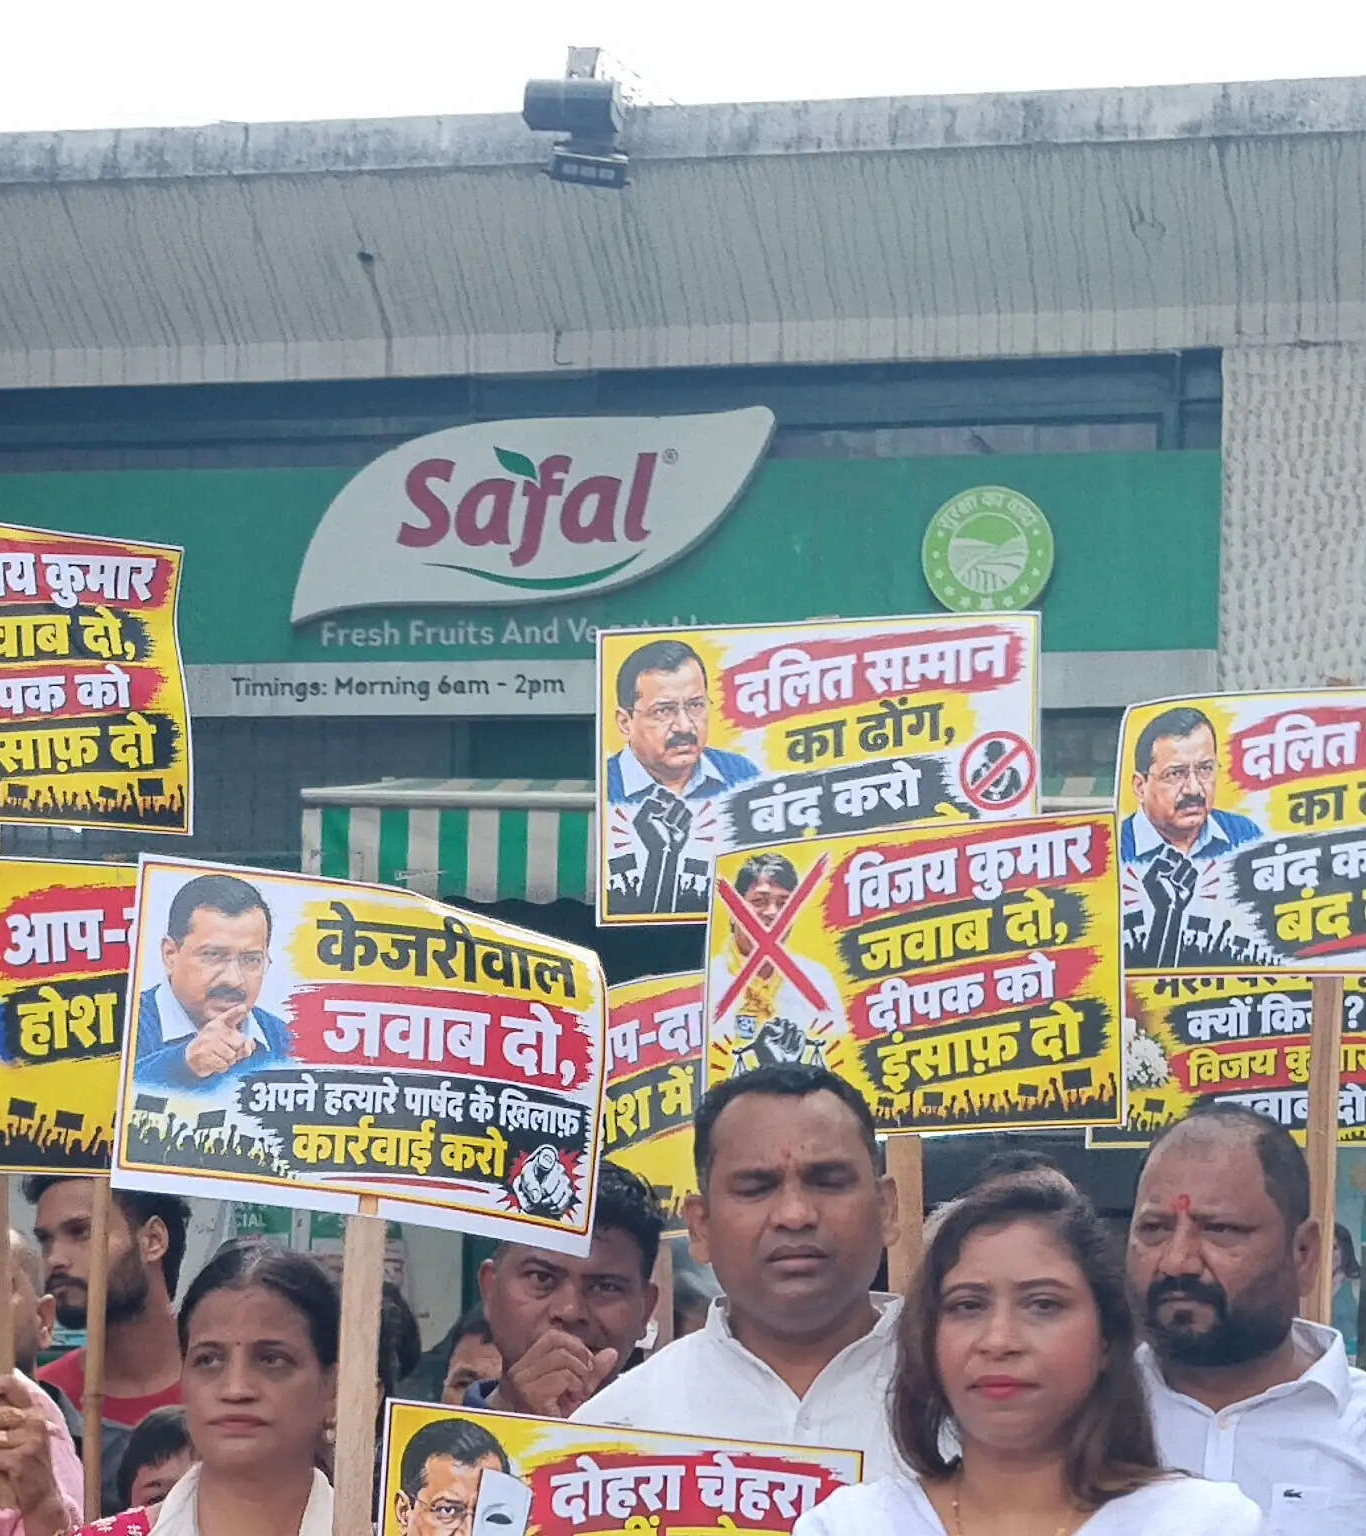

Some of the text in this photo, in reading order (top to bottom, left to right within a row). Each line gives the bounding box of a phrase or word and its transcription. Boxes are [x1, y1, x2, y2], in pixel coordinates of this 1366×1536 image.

[396, 452, 659, 568] Safal
[42, 552, 157, 609] कुमार
[81, 606, 137, 662] दो,
[321, 621, 401, 647] Fresh
[409, 619, 495, 647] Fruits
[502, 618, 560, 645] And
[73, 664, 130, 709] को
[232, 675, 328, 702] Timings:
[335, 674, 431, 702] Morning
[438, 675, 491, 696] 6am
[514, 674, 566, 701] 2pm
[734, 634, 1011, 719] दलित सम्मान
[111, 711, 159, 769] दो
[786, 720, 844, 764] का
[1242, 714, 1359, 779] दलित
[749, 784, 823, 834] बंद
[831, 764, 922, 818] करो
[1288, 783, 1346, 827] का
[845, 825, 1093, 917] विजय कुमार
[1252, 842, 1322, 892] बंद
[858, 889, 1069, 973] जवाब दो,
[1275, 887, 1353, 943] बंद
[315, 901, 580, 998] केजरीवाल
[17, 986, 118, 1056] होश
[867, 952, 1057, 1036] दीपक को
[1186, 995, 1254, 1041] क्यों
[324, 997, 579, 1087] जवाब दो,
[876, 1000, 1087, 1095] इंसाफ़ दो
[1186, 1047, 1278, 1088] विजय
[249, 1074, 317, 1113] अपने
[323, 1077, 399, 1116] हत्यारे
[404, 1079, 466, 1122] पार्षद
[469, 1085, 495, 1124] के
[657, 1065, 695, 1116] में
[292, 1115, 508, 1178] कार्रवाई करो
[551, 1452, 822, 1526] दोहरा चेहरा
